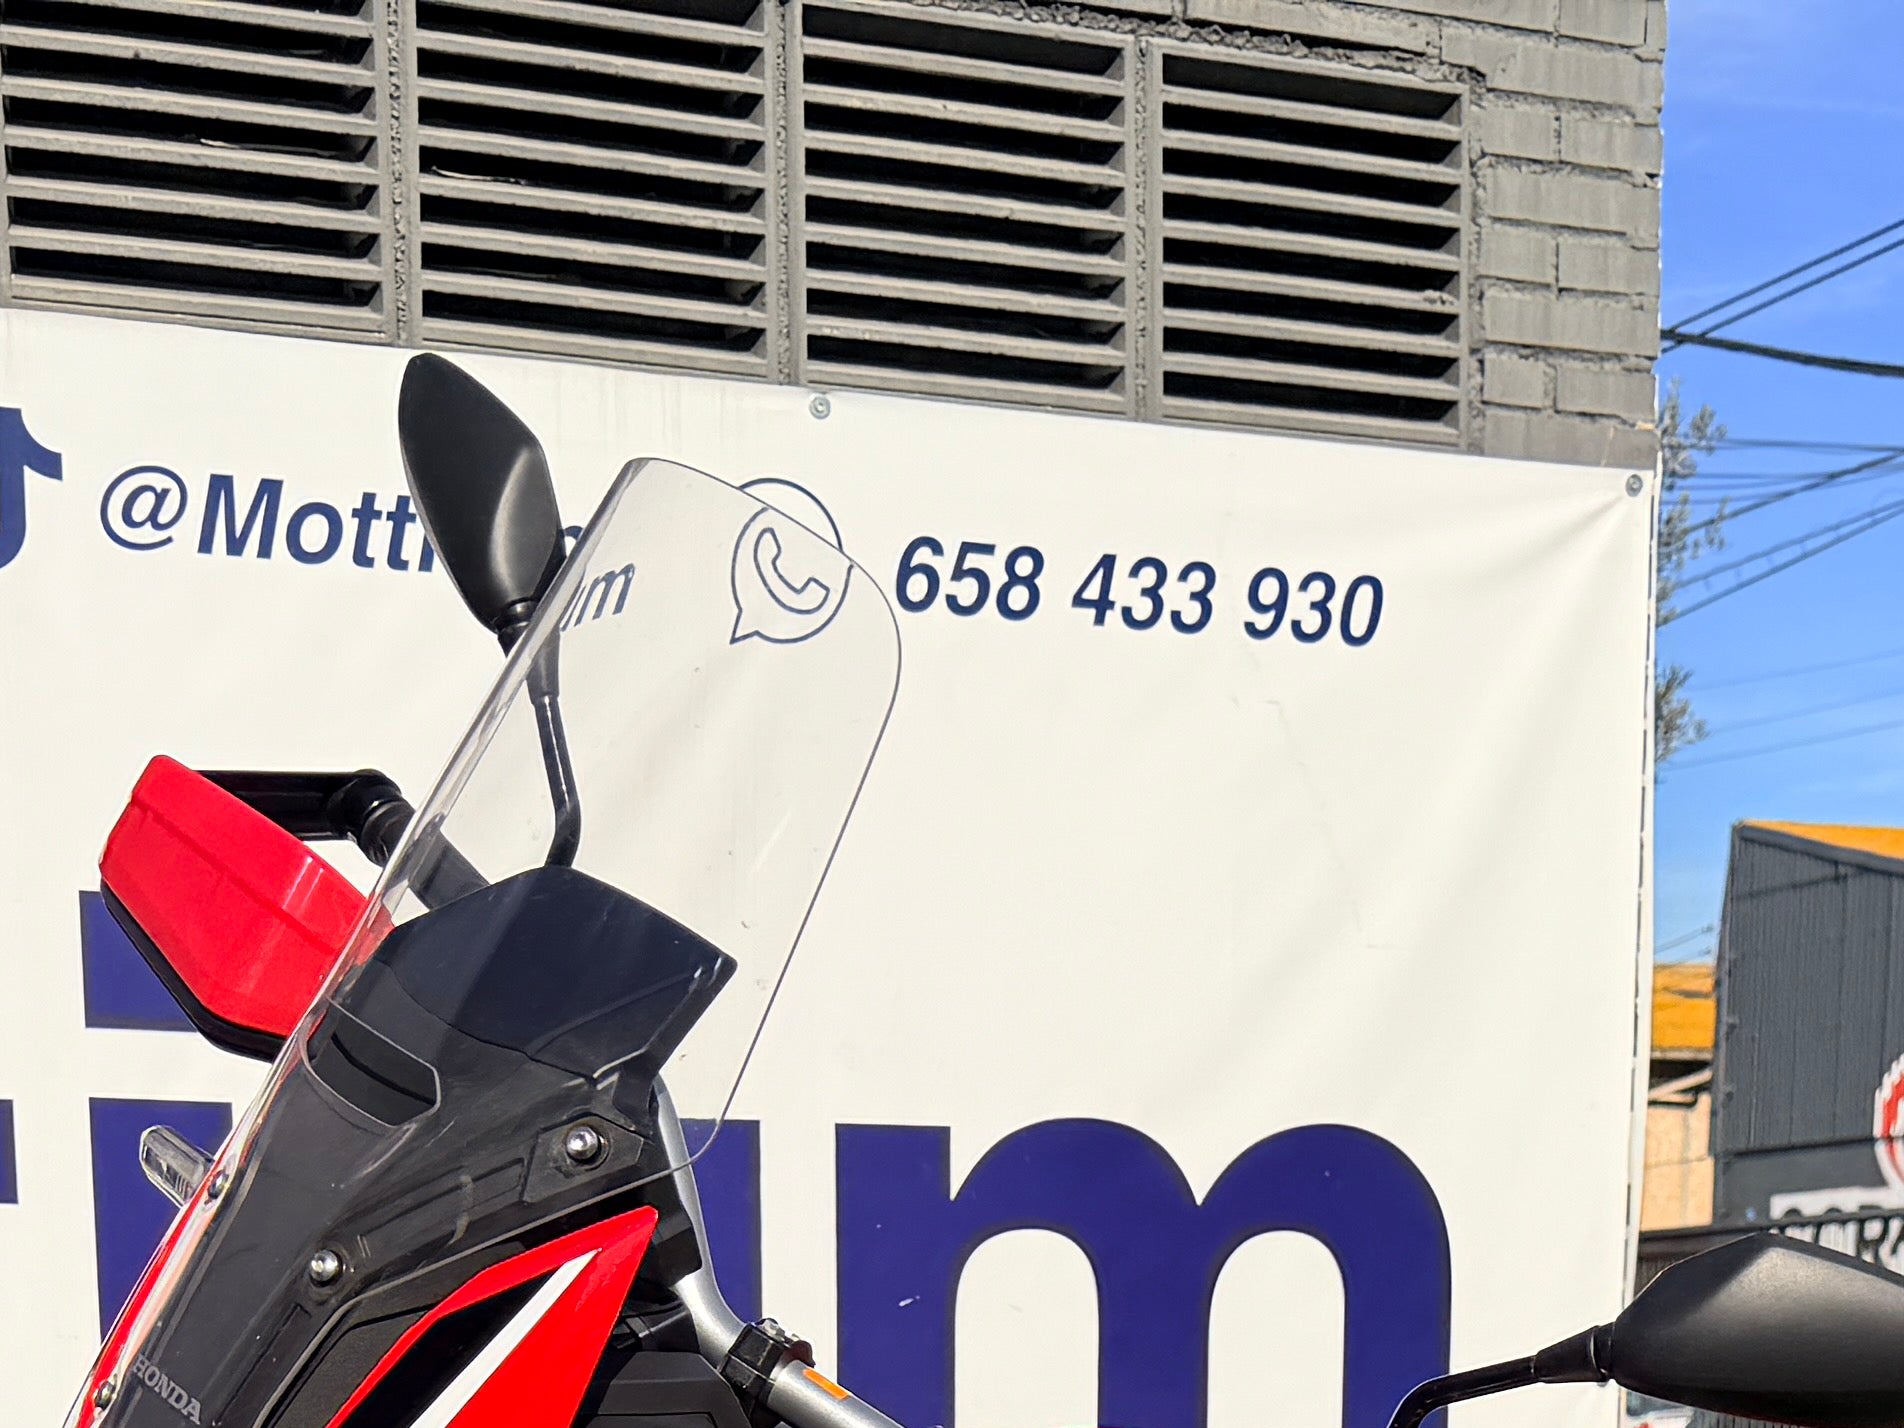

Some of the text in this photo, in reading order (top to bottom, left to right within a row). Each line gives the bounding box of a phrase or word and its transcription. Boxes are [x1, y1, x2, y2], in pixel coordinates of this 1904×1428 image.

[99, 465, 636, 632] @Mottm
[896, 535, 1384, 647] 658 433 930
[132, 1353, 202, 1425] HONDA
